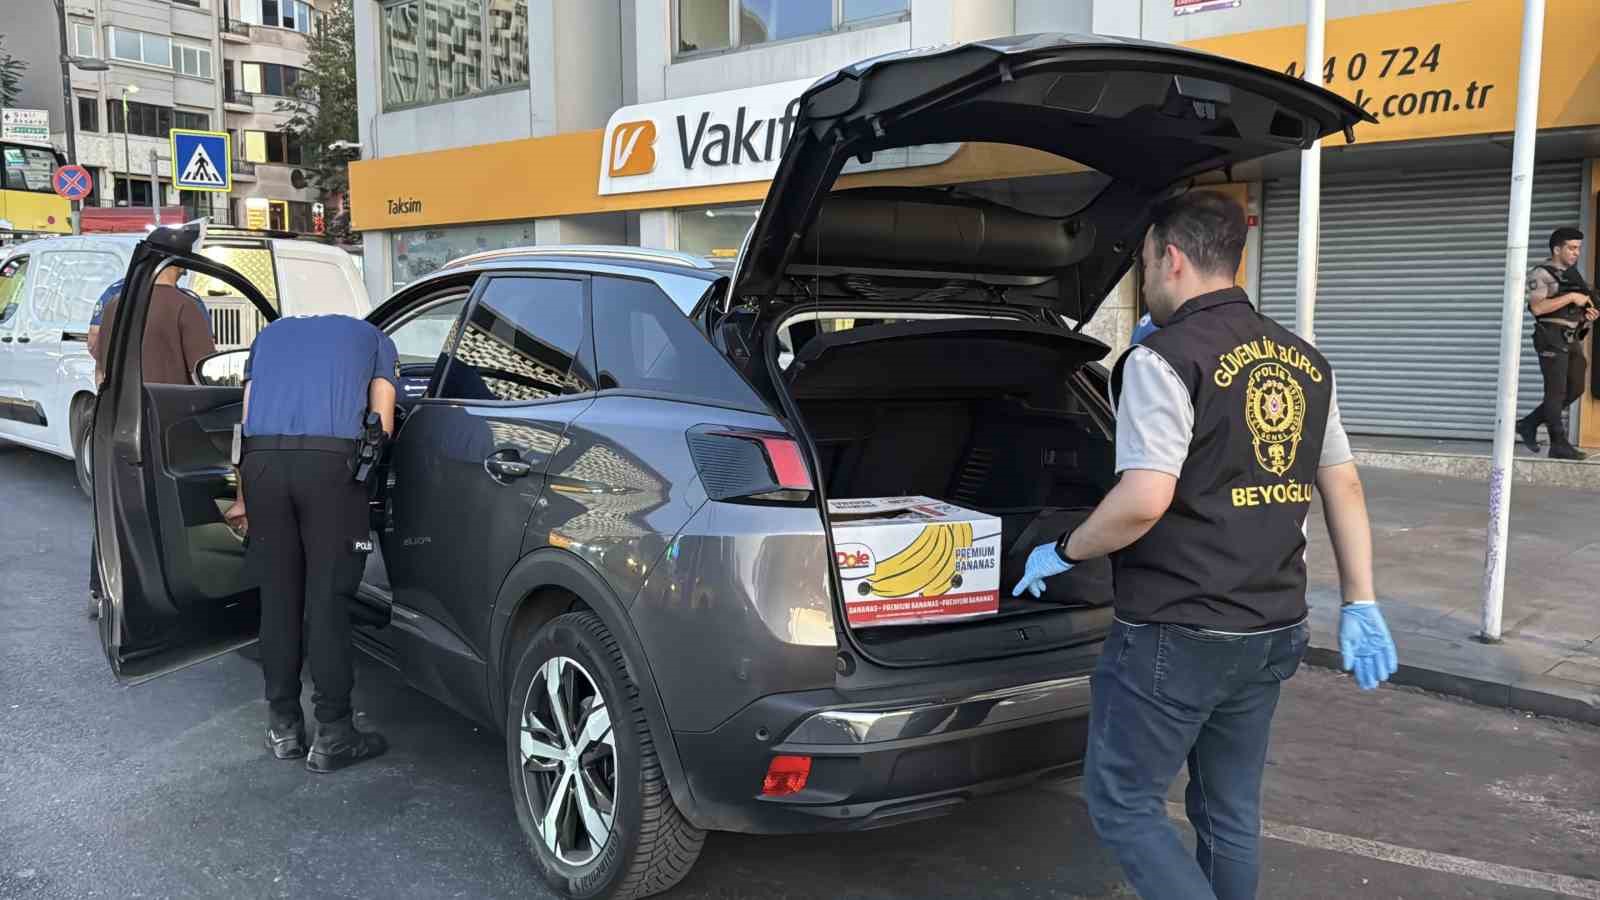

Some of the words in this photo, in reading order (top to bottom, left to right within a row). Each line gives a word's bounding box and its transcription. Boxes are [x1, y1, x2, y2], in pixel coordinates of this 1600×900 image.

[1347, 52, 1367, 81] 0
[1378, 43, 1441, 78] 724
[387, 196, 422, 215] Taksim
[1214, 336, 1278, 387] GÜVENLİK
[1278, 344, 1322, 382] BÜRO
[1232, 478, 1313, 507] BEYOĞLU
[832, 550, 869, 566] Dole
[955, 546, 995, 558] PREMIUM
[955, 558, 996, 572] BANANAS
